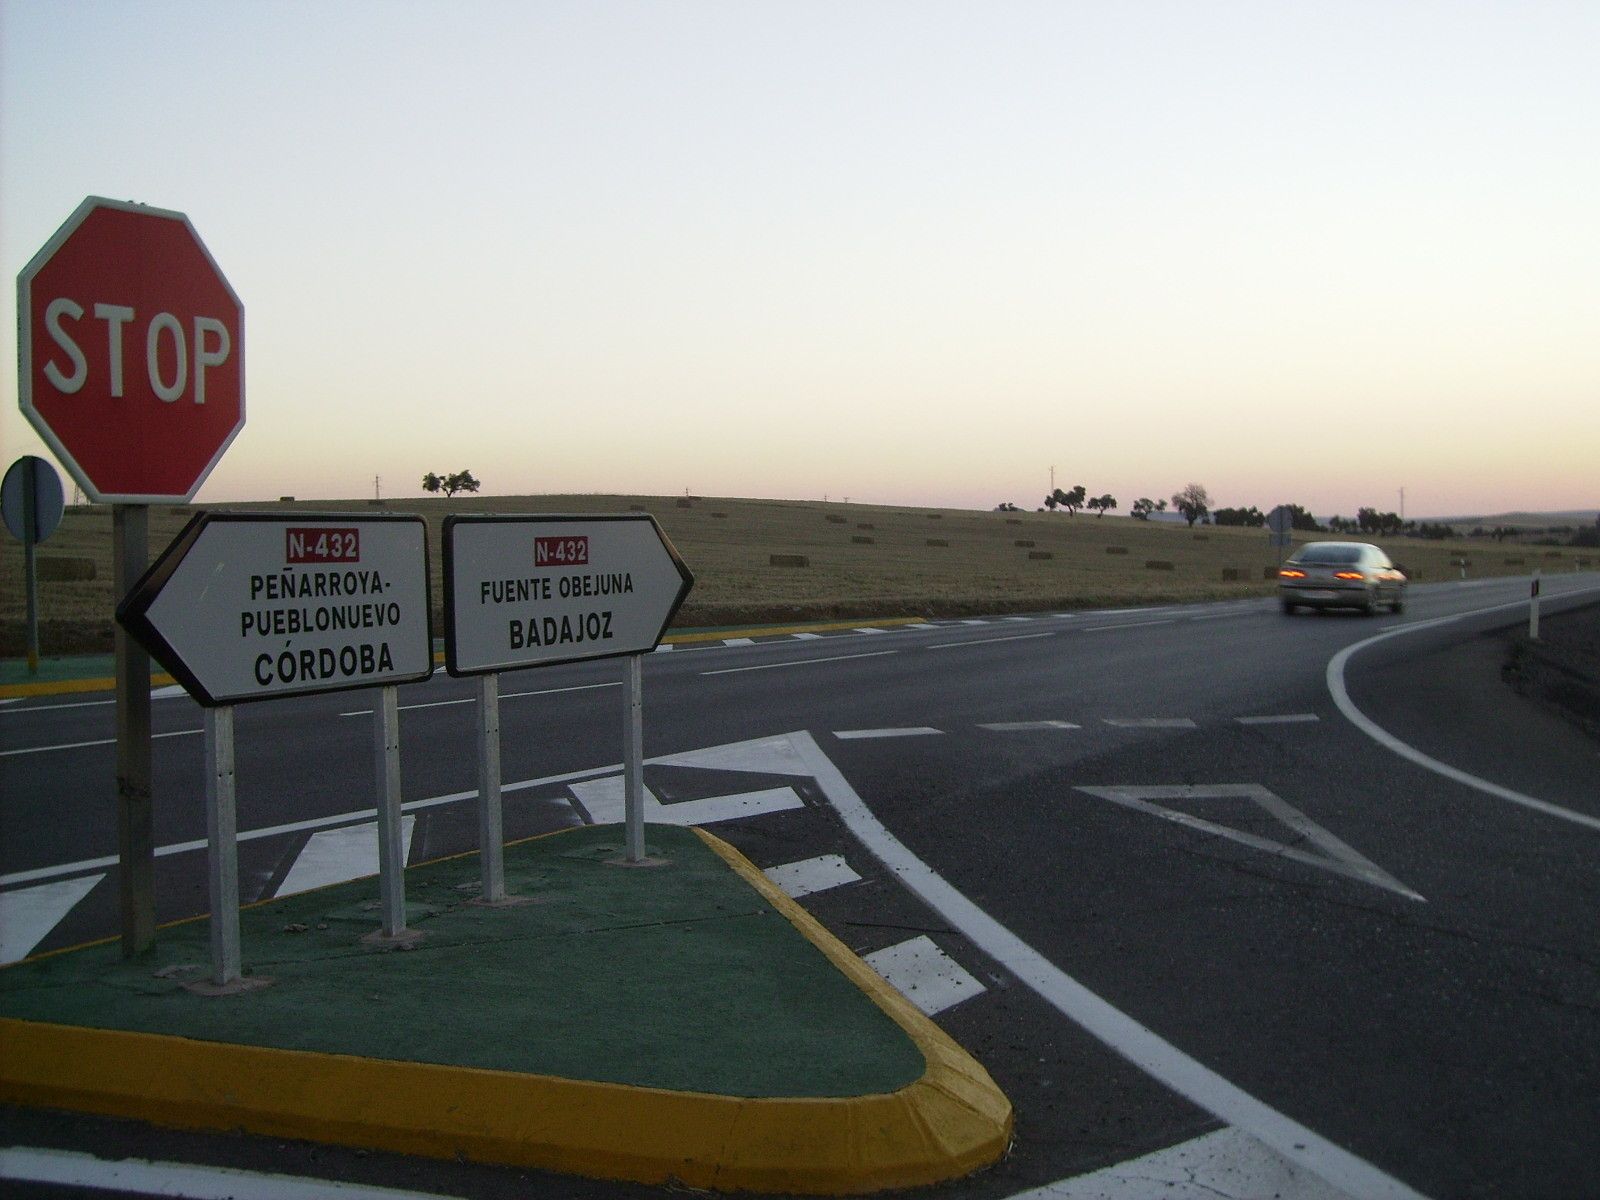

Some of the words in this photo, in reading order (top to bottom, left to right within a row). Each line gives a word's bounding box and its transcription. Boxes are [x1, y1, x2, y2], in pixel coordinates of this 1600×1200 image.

[43, 297, 231, 404] STOP
[289, 532, 358, 558] N-432
[536, 540, 587, 563] N-432
[250, 567, 391, 600] PEÑARROYA-
[481, 578, 552, 604] FUENTE
[559, 573, 634, 598] OBEJUNA
[241, 602, 400, 637] PUEBLONUEVO
[510, 611, 613, 650] BADAJOZ
[255, 640, 394, 686] CÓRDOBA
